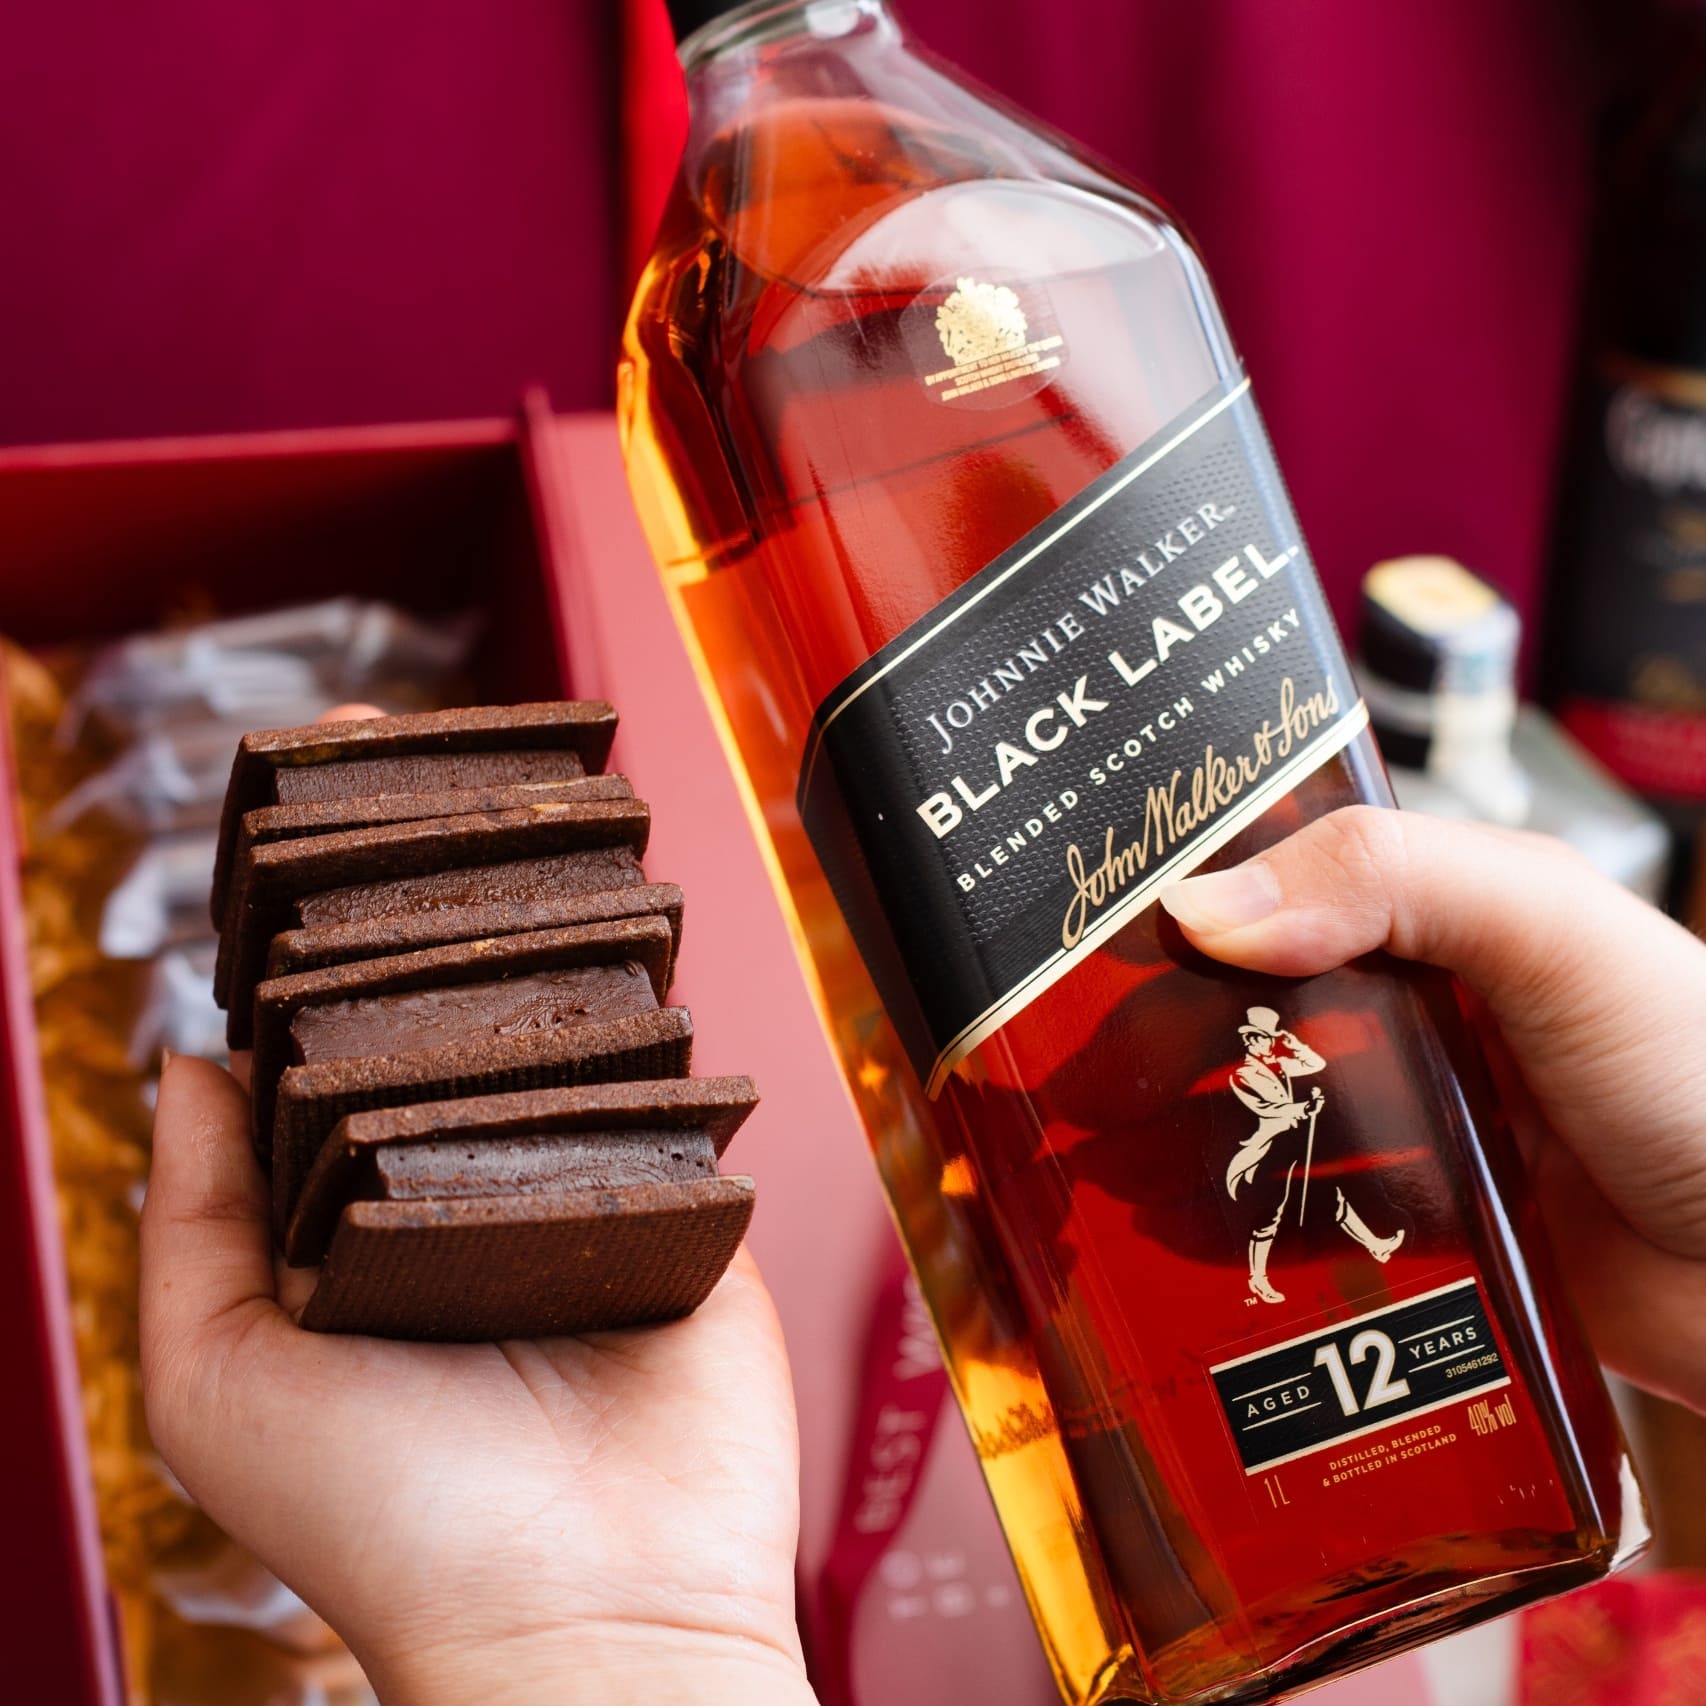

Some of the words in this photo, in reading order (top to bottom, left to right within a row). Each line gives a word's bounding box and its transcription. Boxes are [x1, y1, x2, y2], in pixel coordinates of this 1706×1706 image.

[925, 614, 1084, 753] JOHNNIE
[1079, 503, 1226, 617] WALKER
[917, 675, 1108, 838] BLACK
[1108, 543, 1291, 686] LABEL
[957, 790, 1078, 892] BLENDED
[1089, 697, 1194, 784] SCOTCH
[1201, 608, 1300, 693] WHISKY
[1062, 827, 1147, 949] John
[1145, 745, 1257, 856] Walker
[1276, 677, 1340, 757] Sons
[1247, 1386, 1311, 1418] AGED
[1313, 1329, 1411, 1417] 12
[1409, 1326, 1477, 1360] YEARS
[1445, 1353, 1499, 1379] 3105461292
[1322, 1477, 1331, 1487] &
[1332, 1460, 1383, 1485] BOTTLED
[1385, 1452, 1398, 1465] IN
[1400, 1432, 1457, 1461] SCOTLAND
[1329, 1444, 1389, 1471] DISTILLED,
[1391, 1424, 1442, 1451] BLENDED
[1467, 1400, 1499, 1436] 40%
[1495, 1393, 1517, 1427] vol
